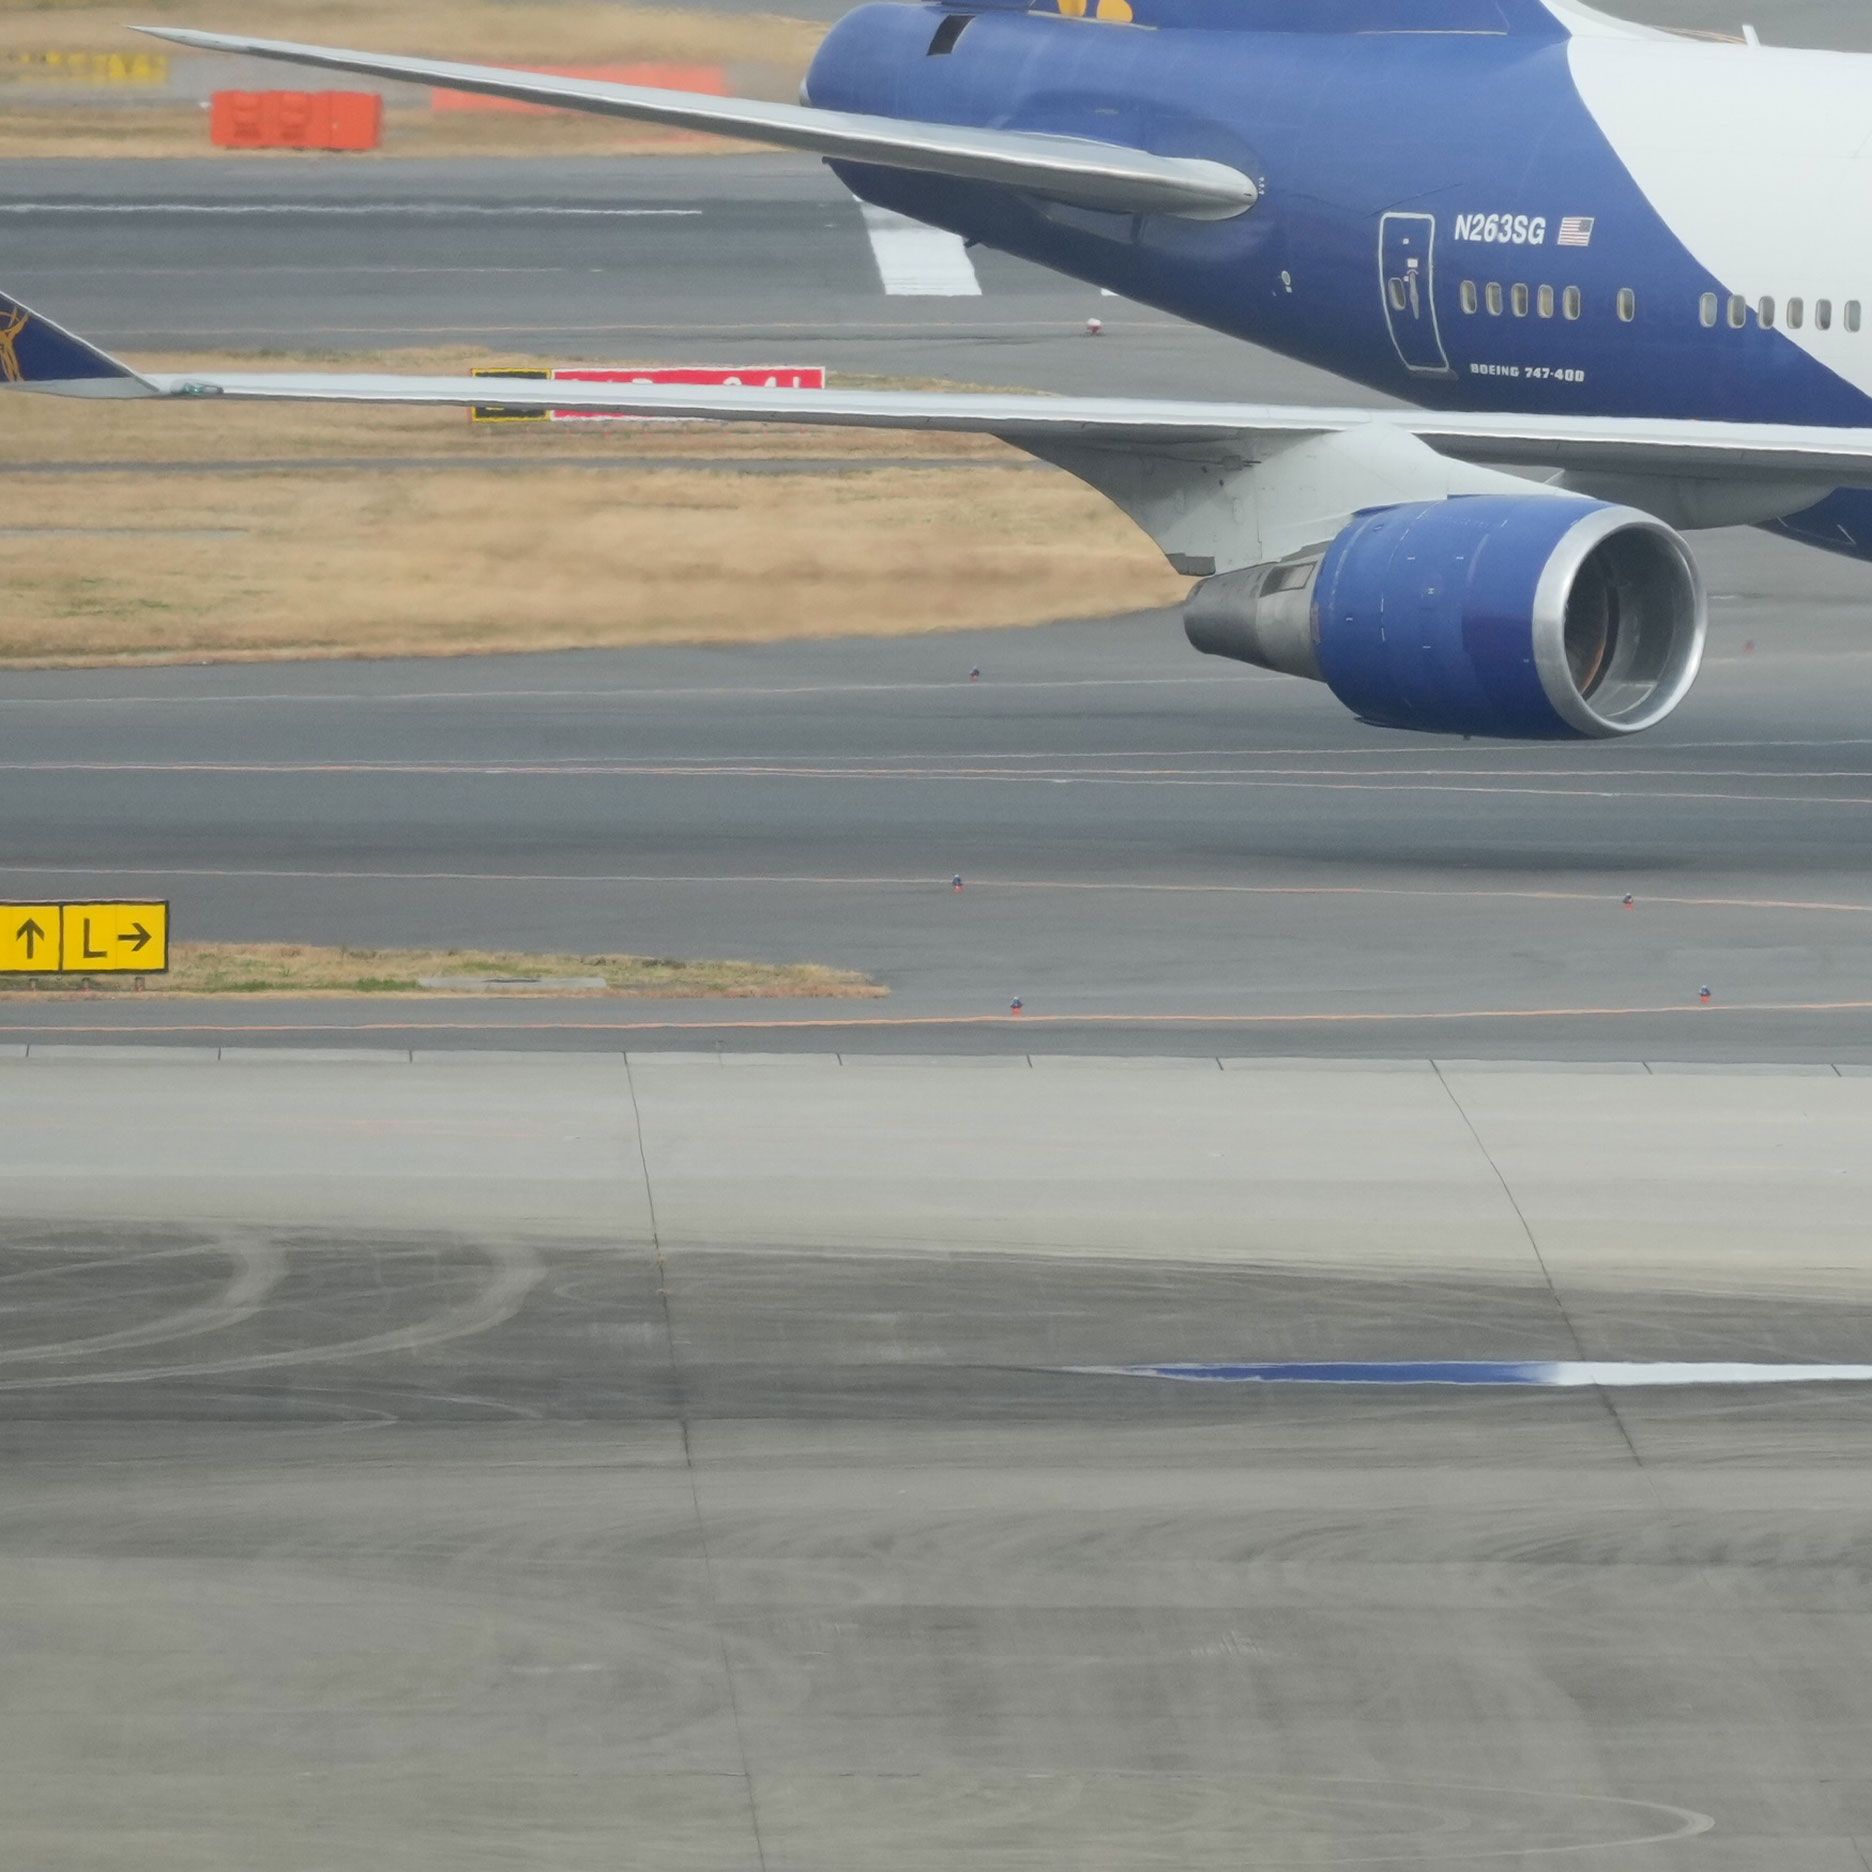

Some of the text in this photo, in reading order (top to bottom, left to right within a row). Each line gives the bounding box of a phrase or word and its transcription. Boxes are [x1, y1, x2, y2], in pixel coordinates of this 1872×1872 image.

[1454, 213, 1546, 245] N263SG
[1470, 363, 1585, 382] BOEING 747-400
[83, 917, 107, 959] L
